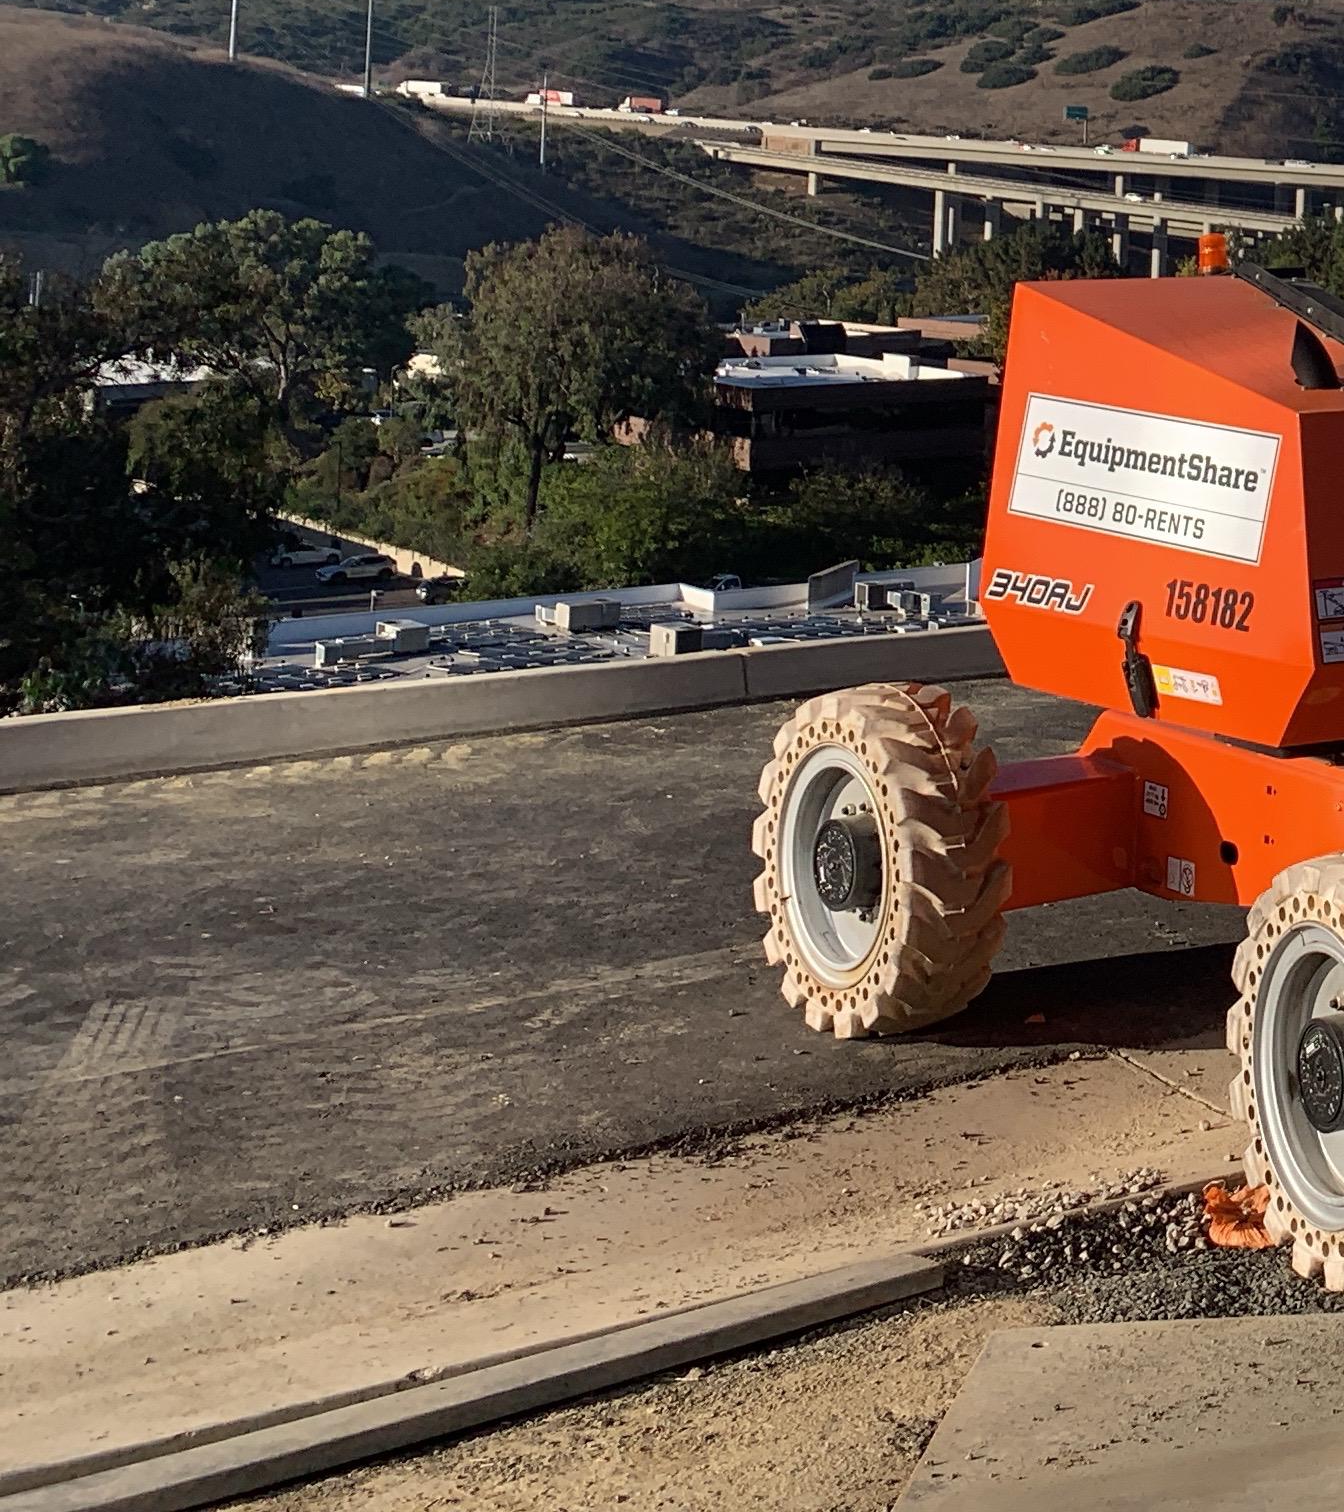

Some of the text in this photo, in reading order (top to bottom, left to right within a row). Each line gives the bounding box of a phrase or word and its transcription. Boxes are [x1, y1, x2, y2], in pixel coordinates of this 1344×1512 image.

[1057, 428, 1259, 493] EquipmentShare
[1055, 488, 1206, 539] (888) 80-RENTS
[986, 569, 1094, 615] 340AJ
[1164, 578, 1255, 632] 158182
